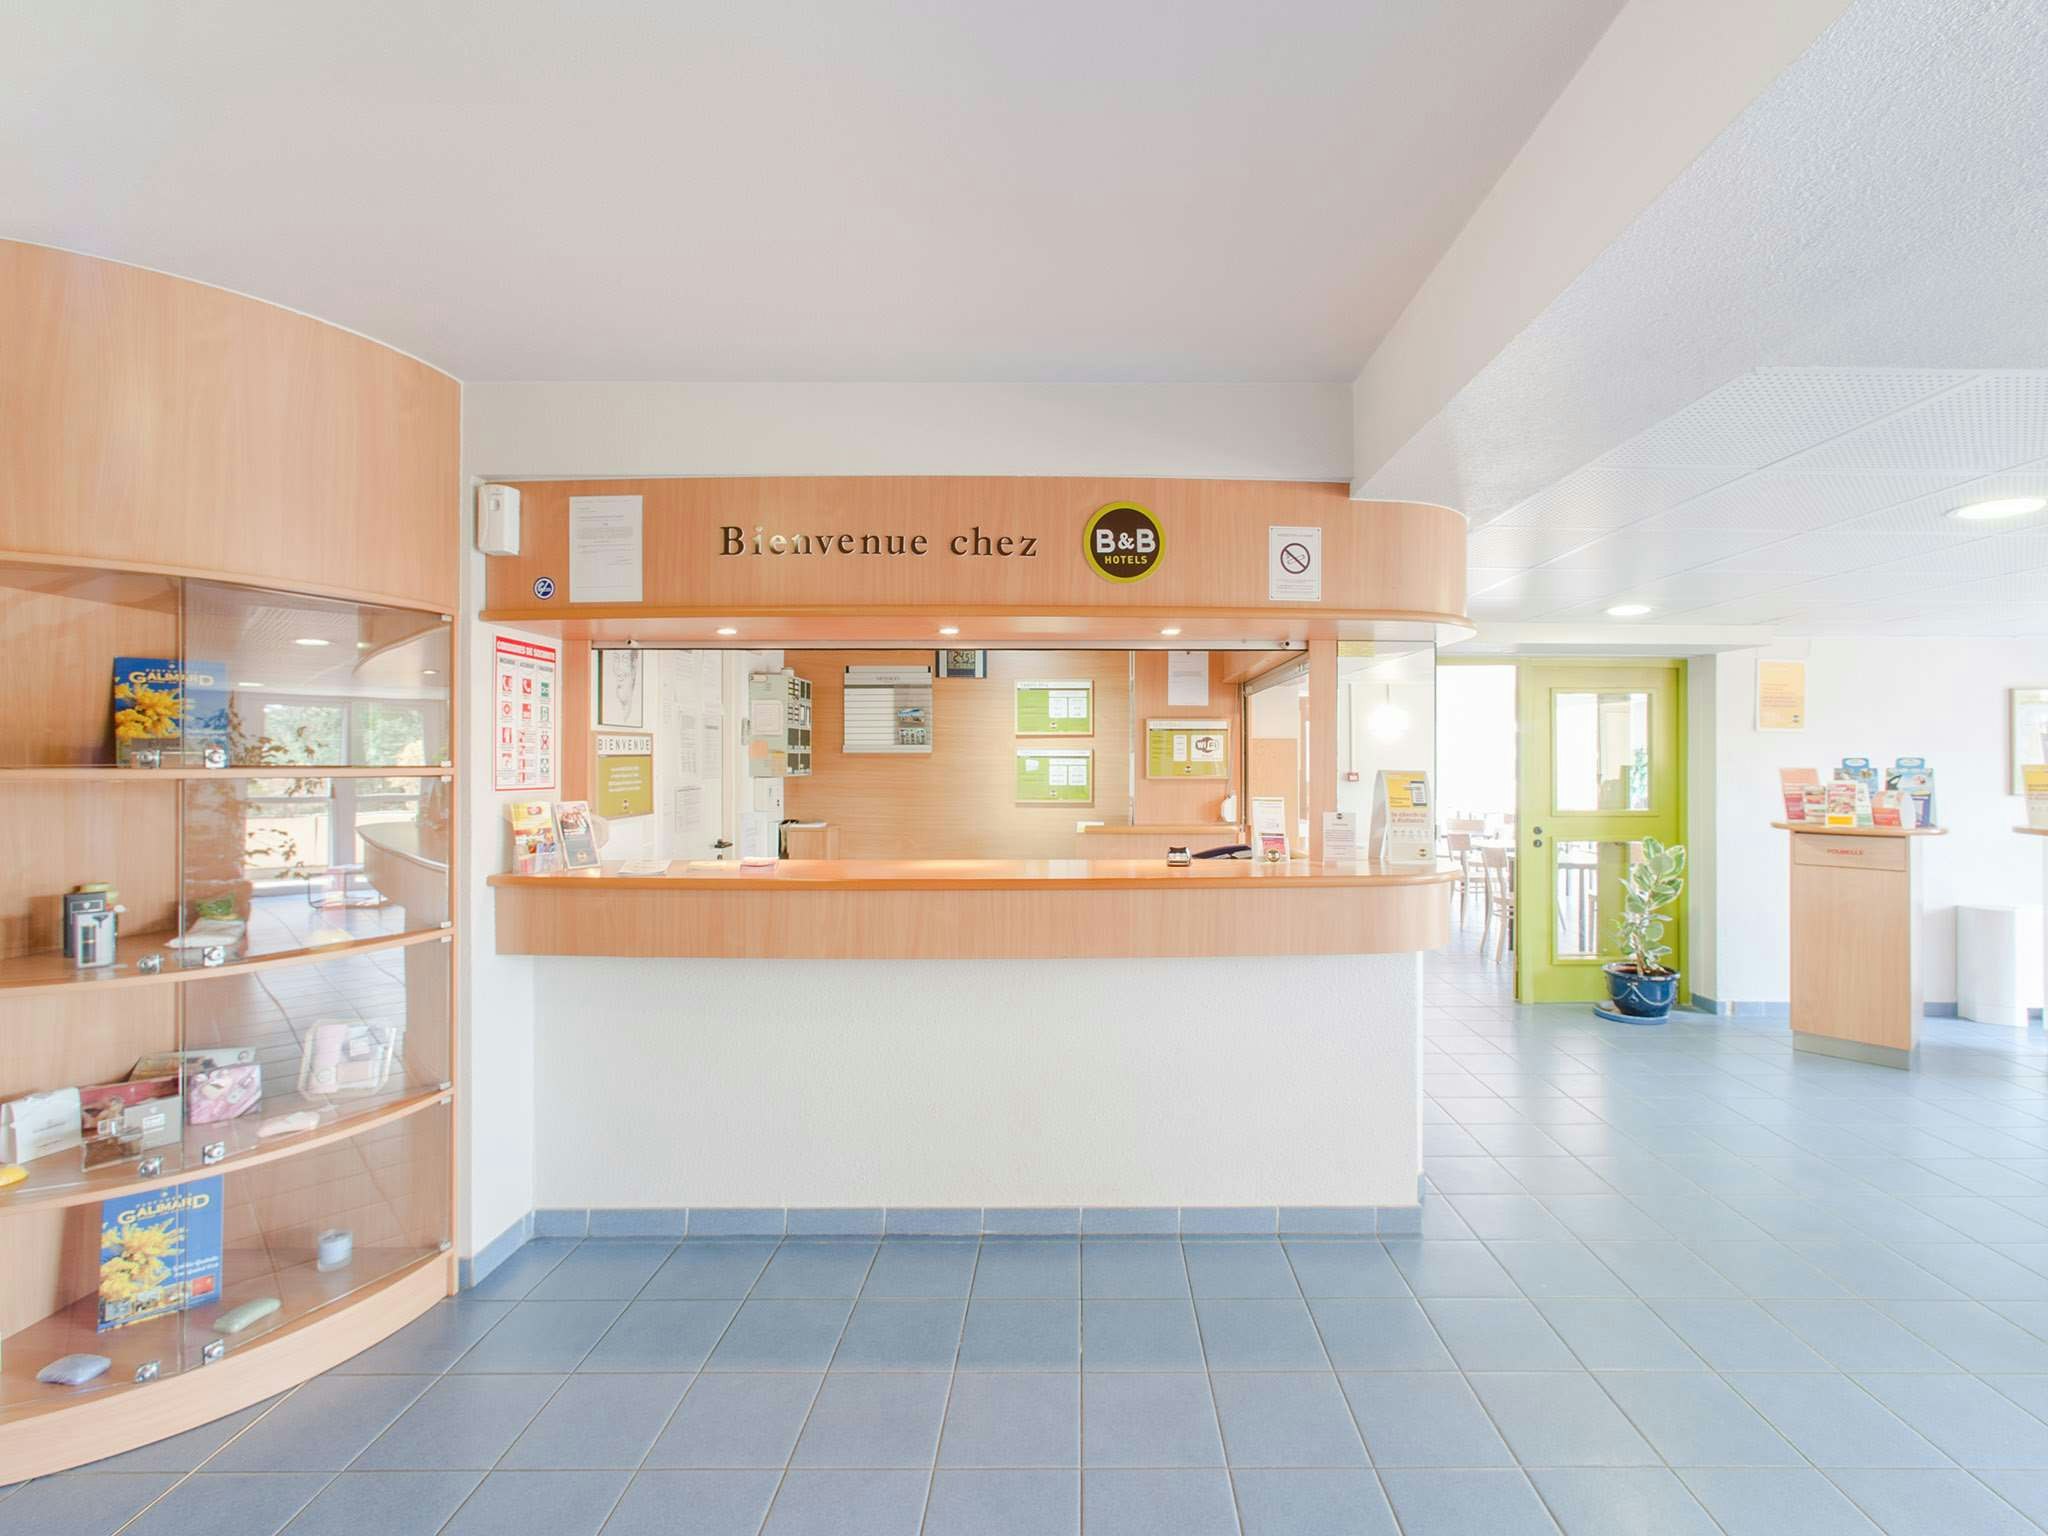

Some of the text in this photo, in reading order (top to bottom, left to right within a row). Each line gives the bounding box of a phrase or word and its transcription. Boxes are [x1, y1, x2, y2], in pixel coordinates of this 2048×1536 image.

[720, 525, 1038, 557] Bienvenue chez
[1096, 528, 1156, 554] B&B
[1104, 555, 1148, 565] HOTELS
[598, 738, 650, 751] BIENVENUE
[118, 1193, 210, 1225] GALIMARD
